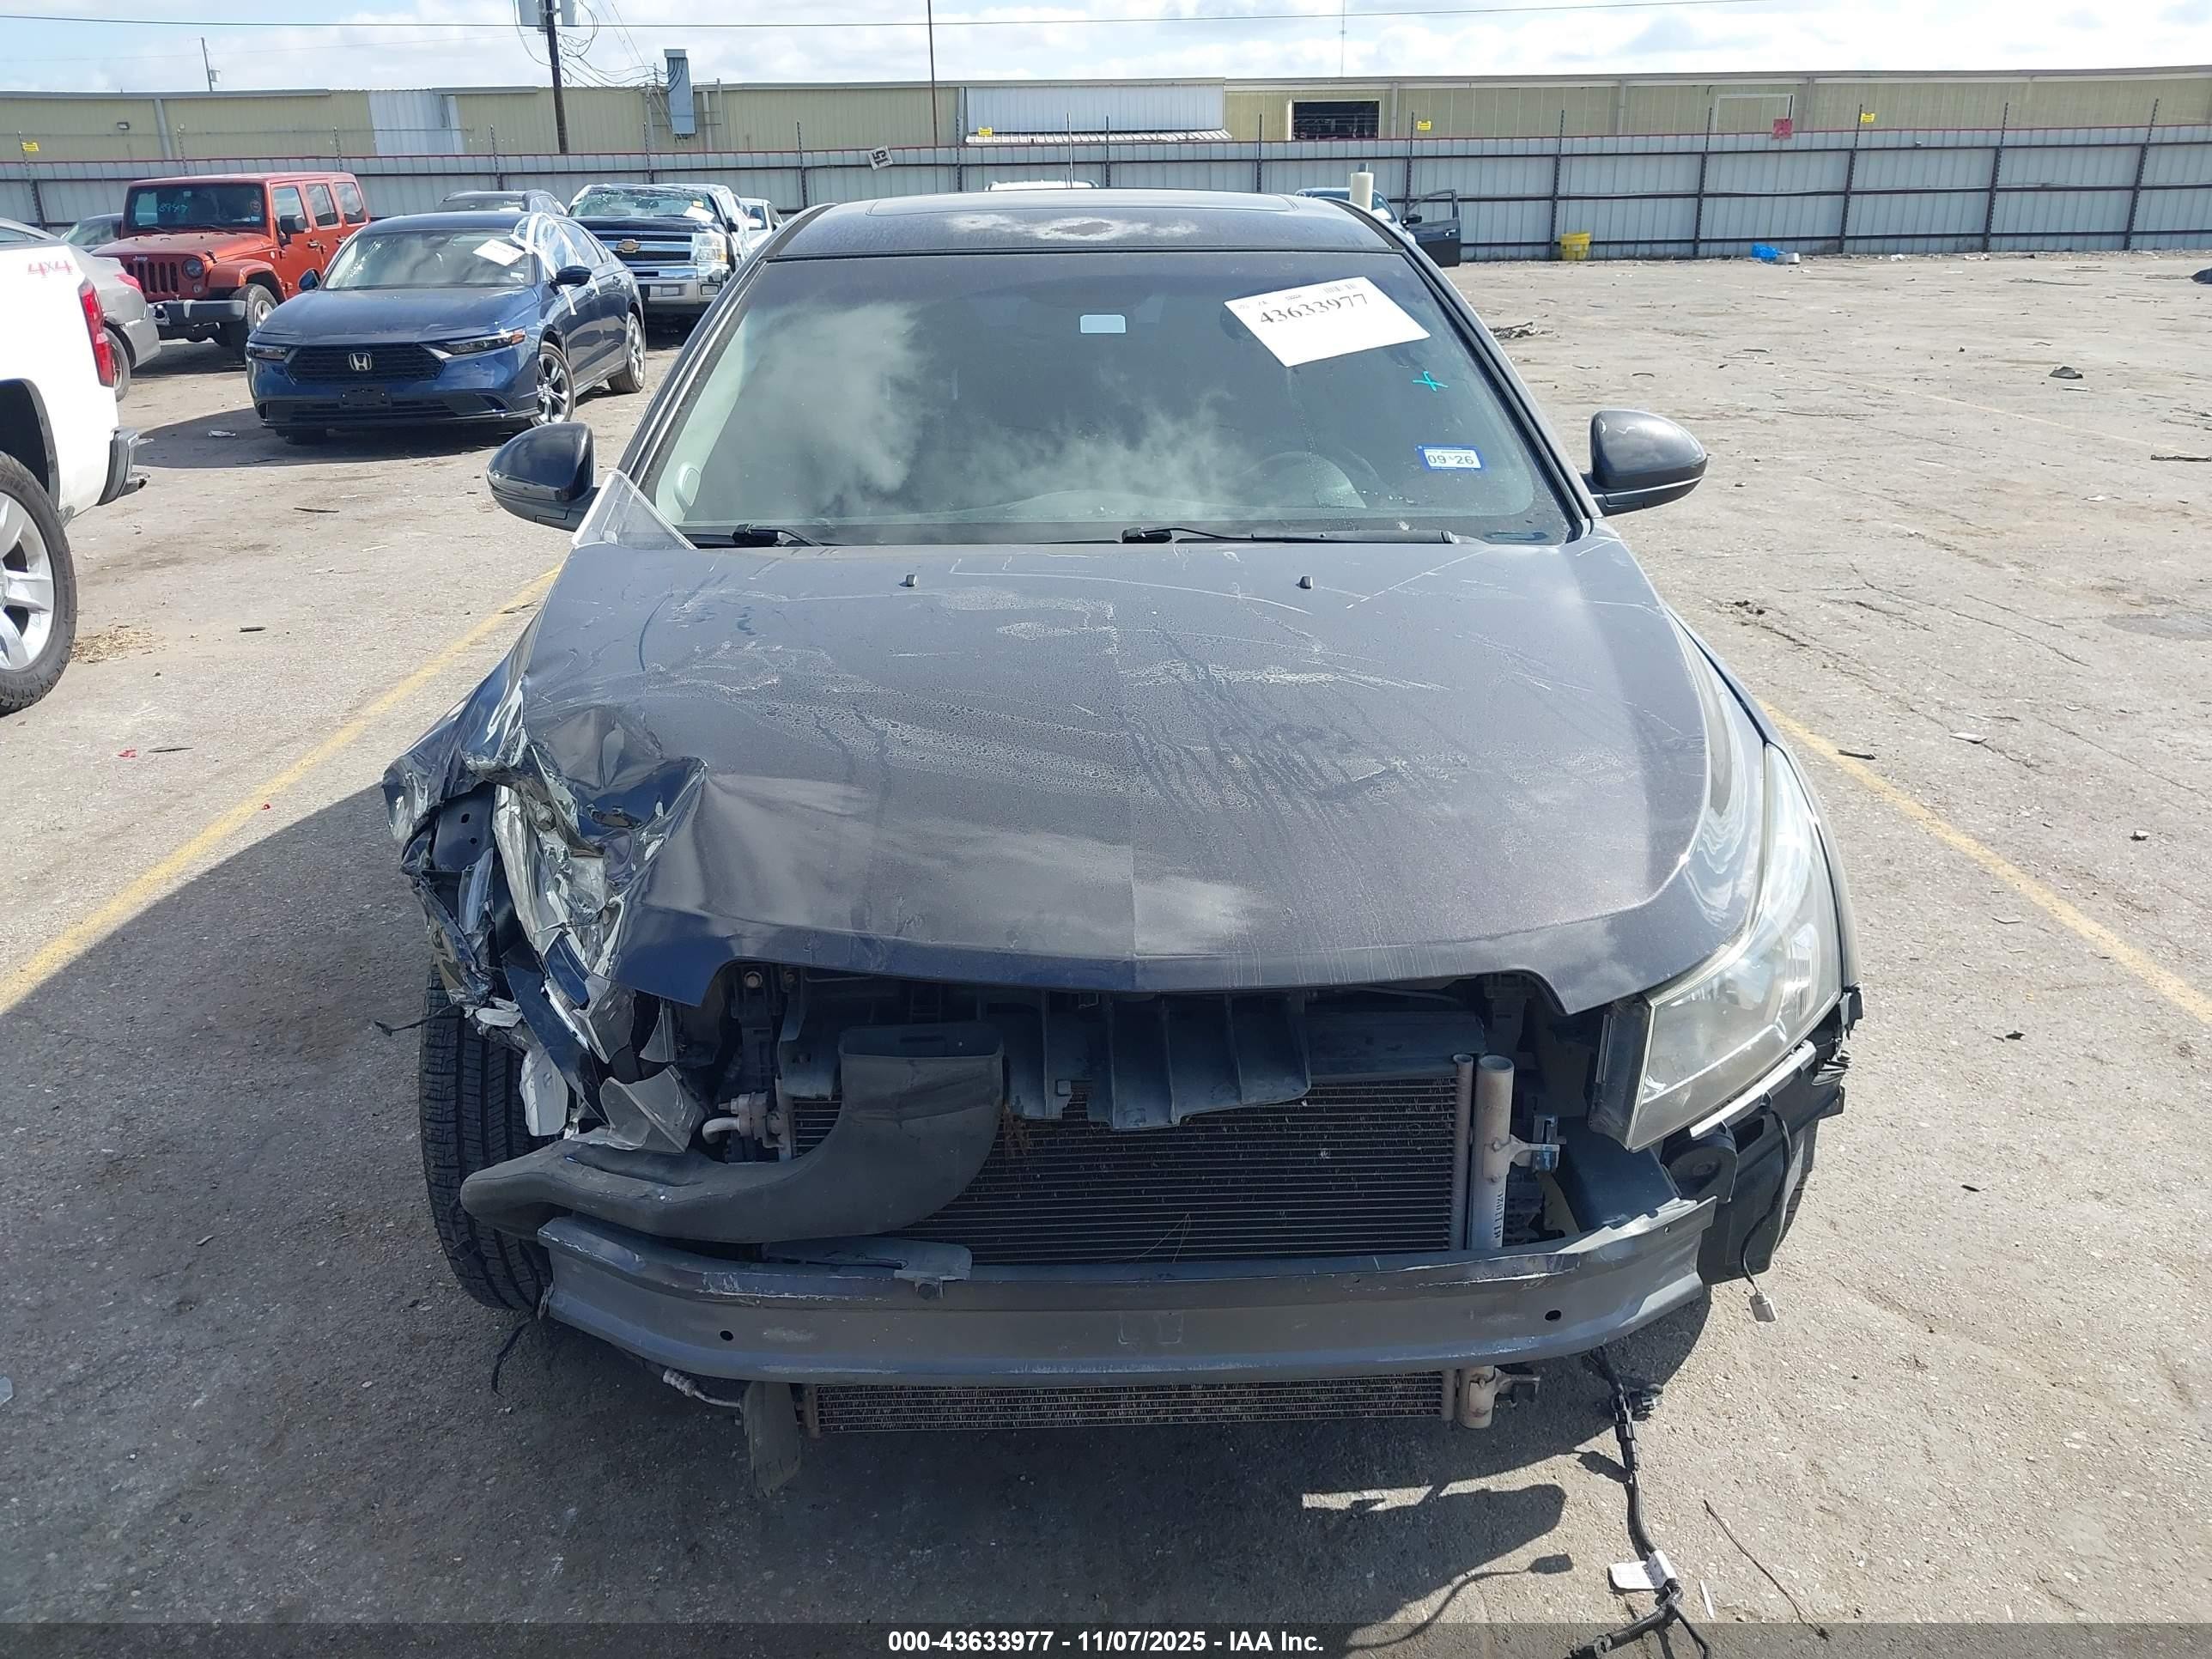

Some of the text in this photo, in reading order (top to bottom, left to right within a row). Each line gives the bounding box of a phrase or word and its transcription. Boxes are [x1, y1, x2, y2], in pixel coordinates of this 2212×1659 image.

[872, 150, 888, 166] 15
[1261, 294, 1368, 323] 43633977
[1427, 454, 1474, 465] 09 26
